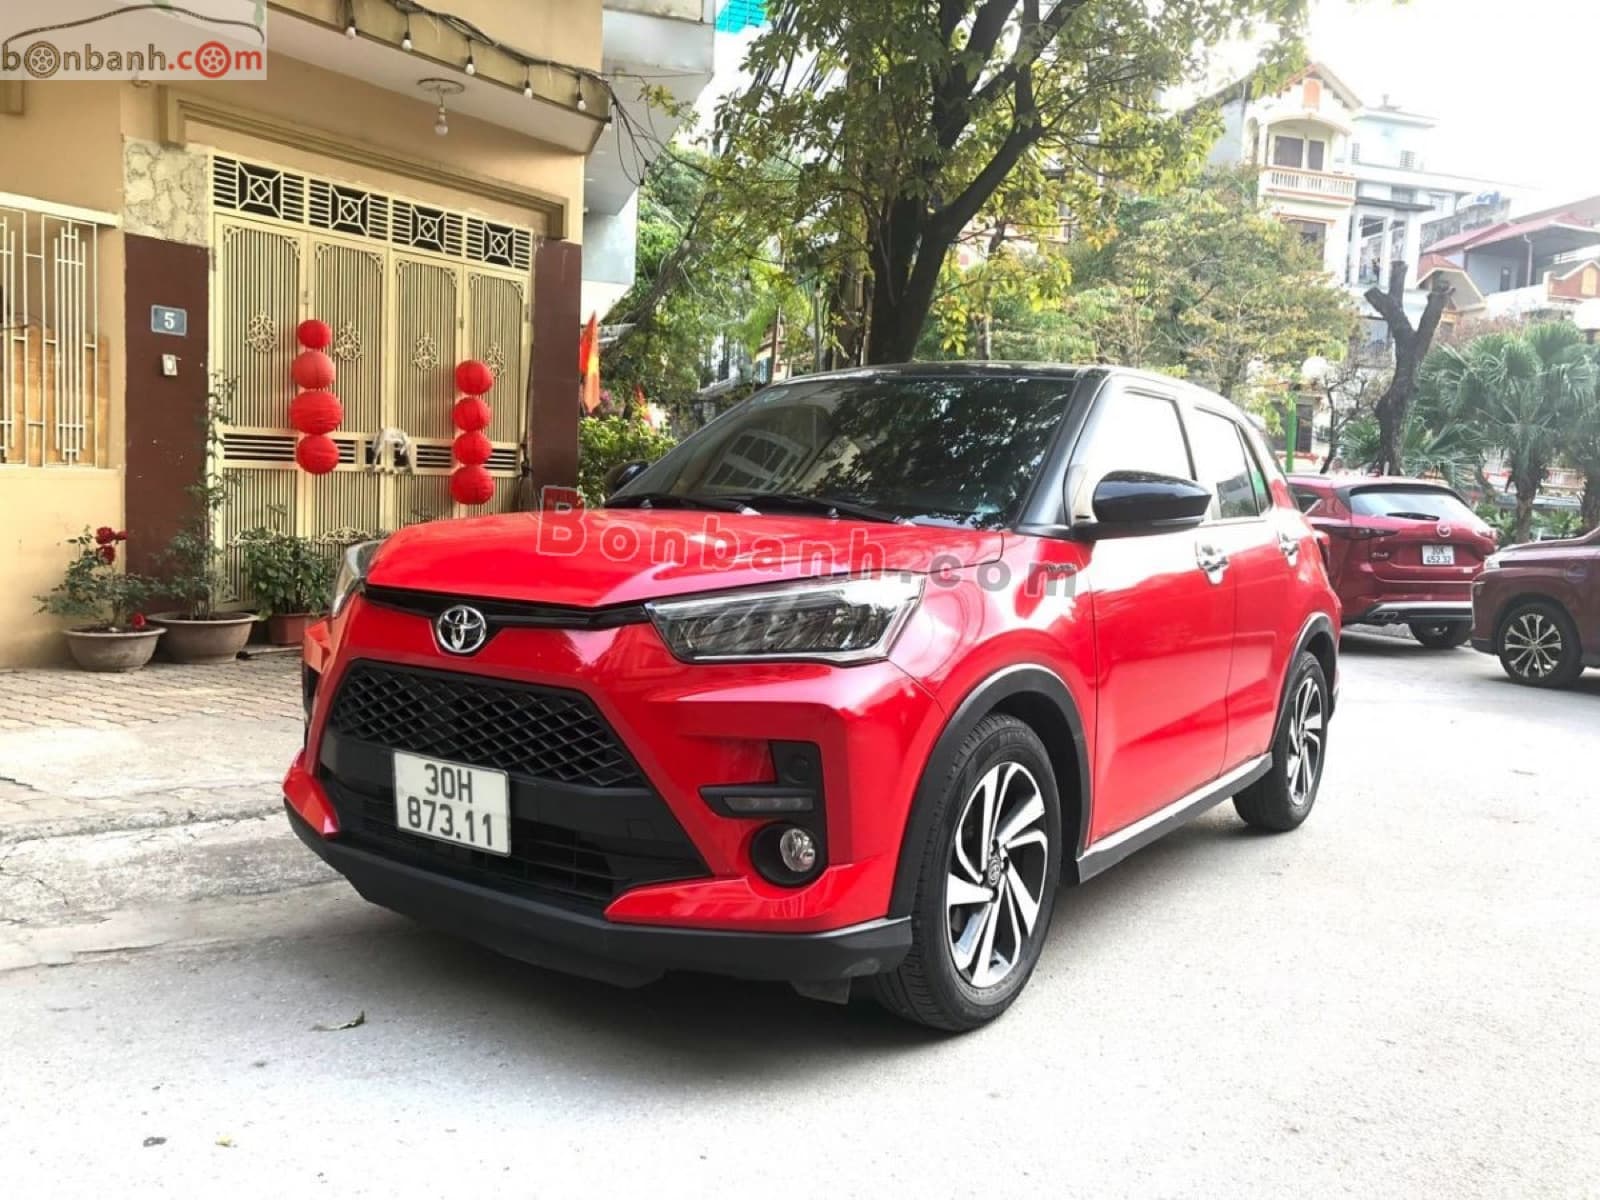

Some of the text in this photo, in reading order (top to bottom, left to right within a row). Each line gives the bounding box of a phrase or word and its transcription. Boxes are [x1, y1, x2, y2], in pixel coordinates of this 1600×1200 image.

[164, 311, 175, 330] 5
[424, 763, 472, 804] 30H
[407, 796, 492, 847] 873.11
